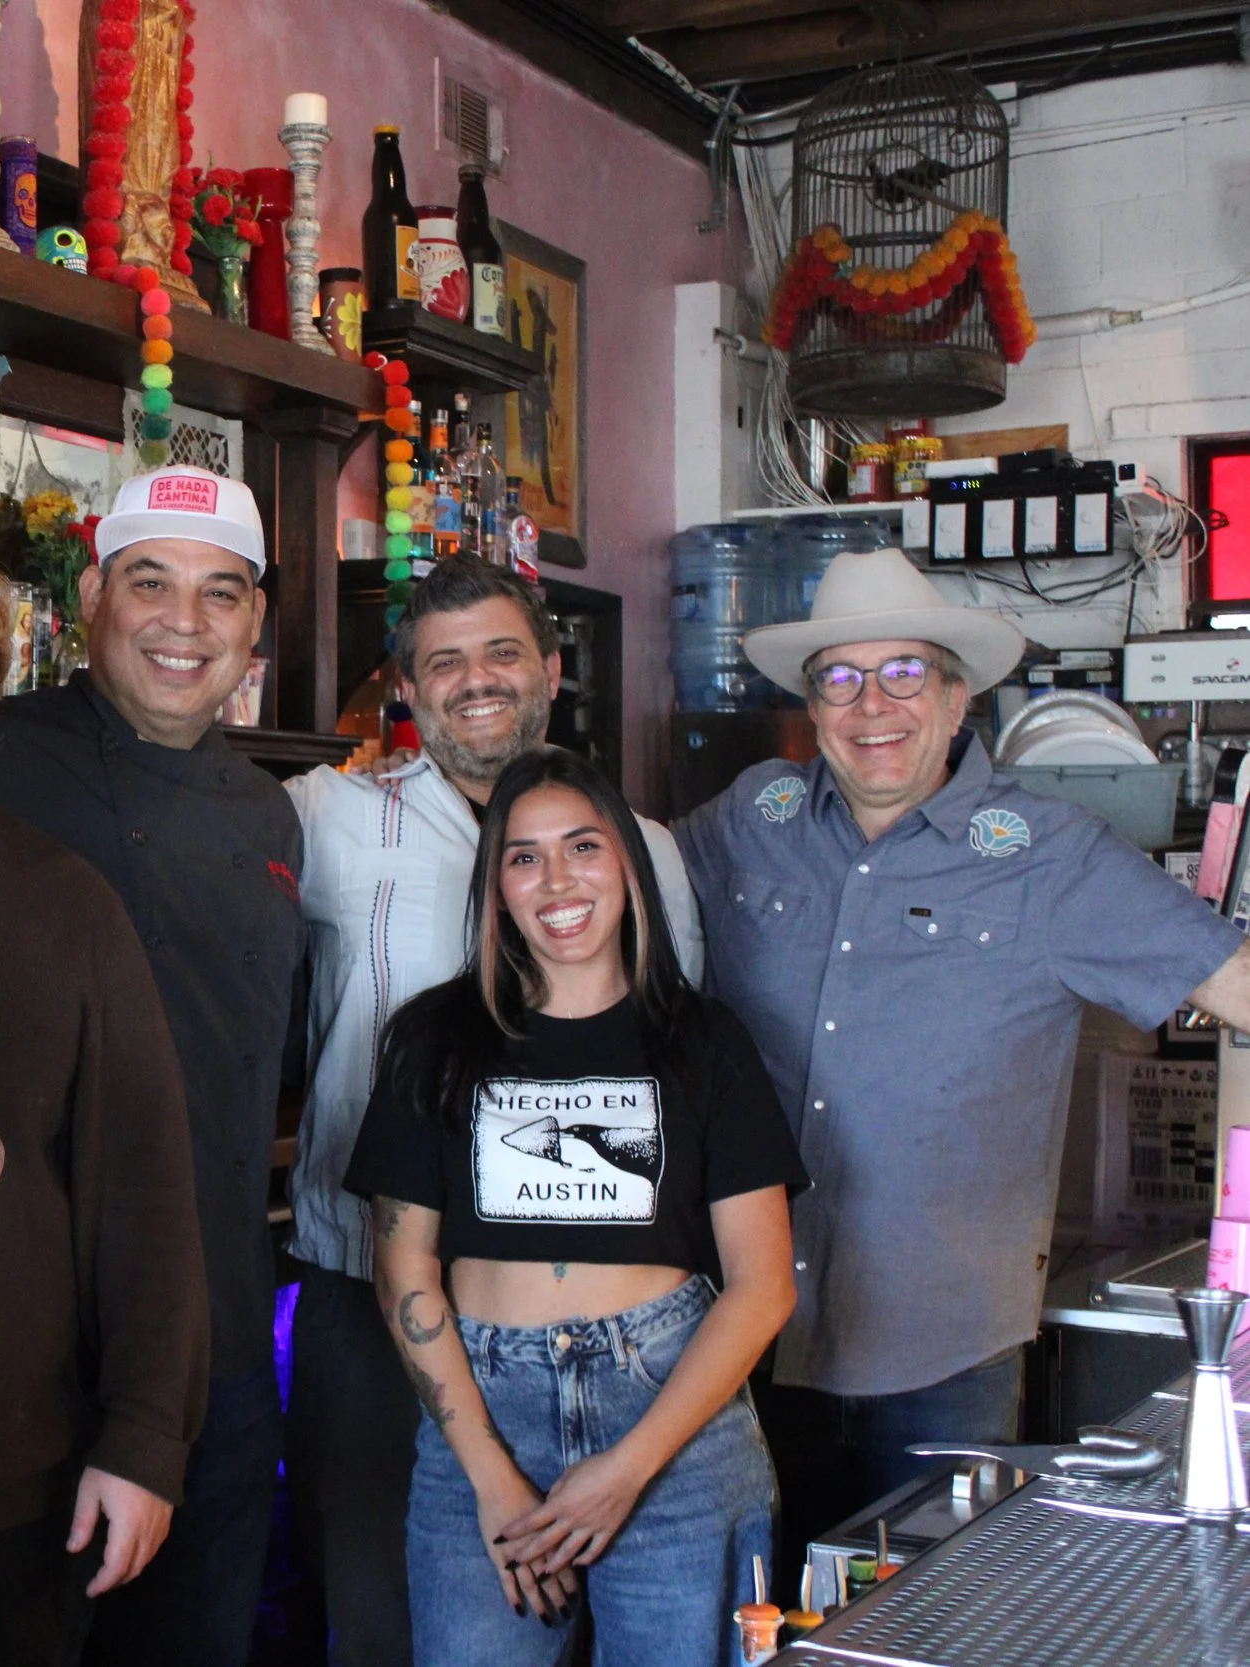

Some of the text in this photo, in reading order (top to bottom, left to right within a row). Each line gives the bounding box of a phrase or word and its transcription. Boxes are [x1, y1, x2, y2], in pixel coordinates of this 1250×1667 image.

[158, 481, 209, 493] DE NADA
[157, 492, 208, 504] CANTINA
[498, 1094, 637, 1111] HECHO EN
[517, 1182, 618, 1201] AUSTIN
